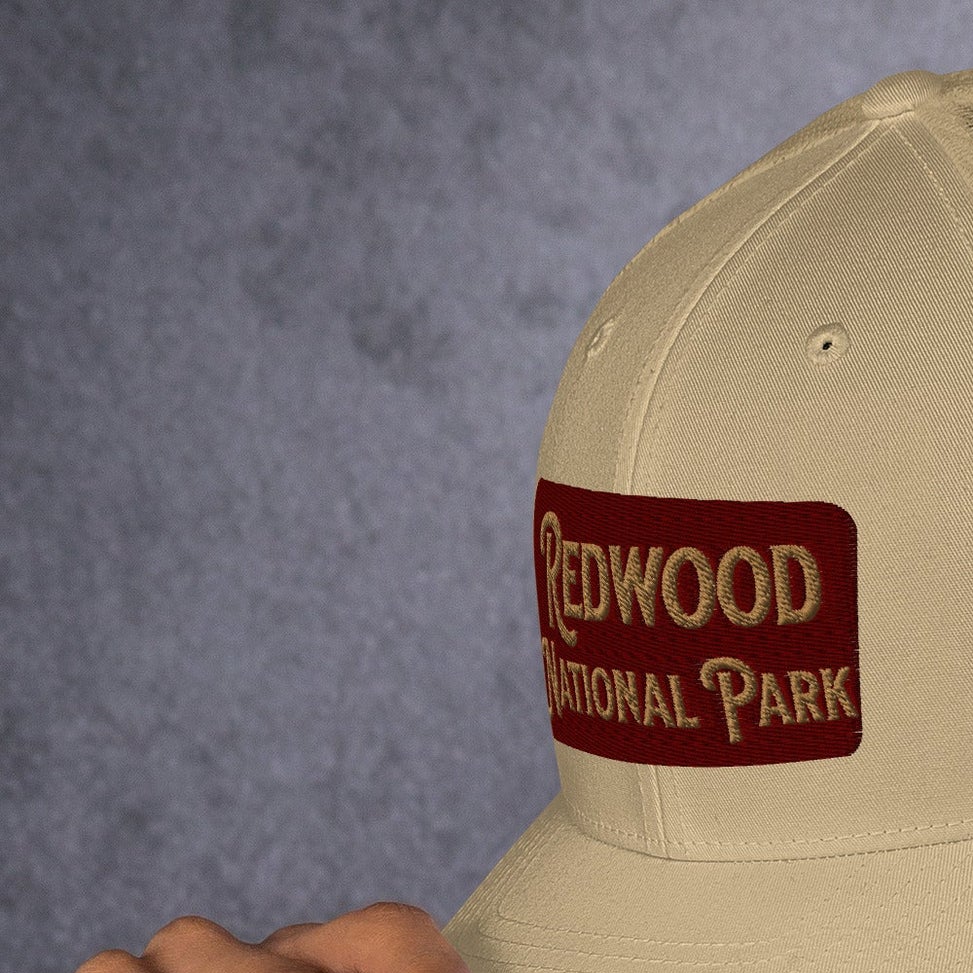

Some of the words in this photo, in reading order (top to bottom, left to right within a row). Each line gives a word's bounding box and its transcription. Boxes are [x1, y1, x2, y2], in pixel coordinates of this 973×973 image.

[540, 511, 822, 647] REDWOOD
[541, 637, 700, 729] NATIONAL
[700, 657, 857, 744] PARK
